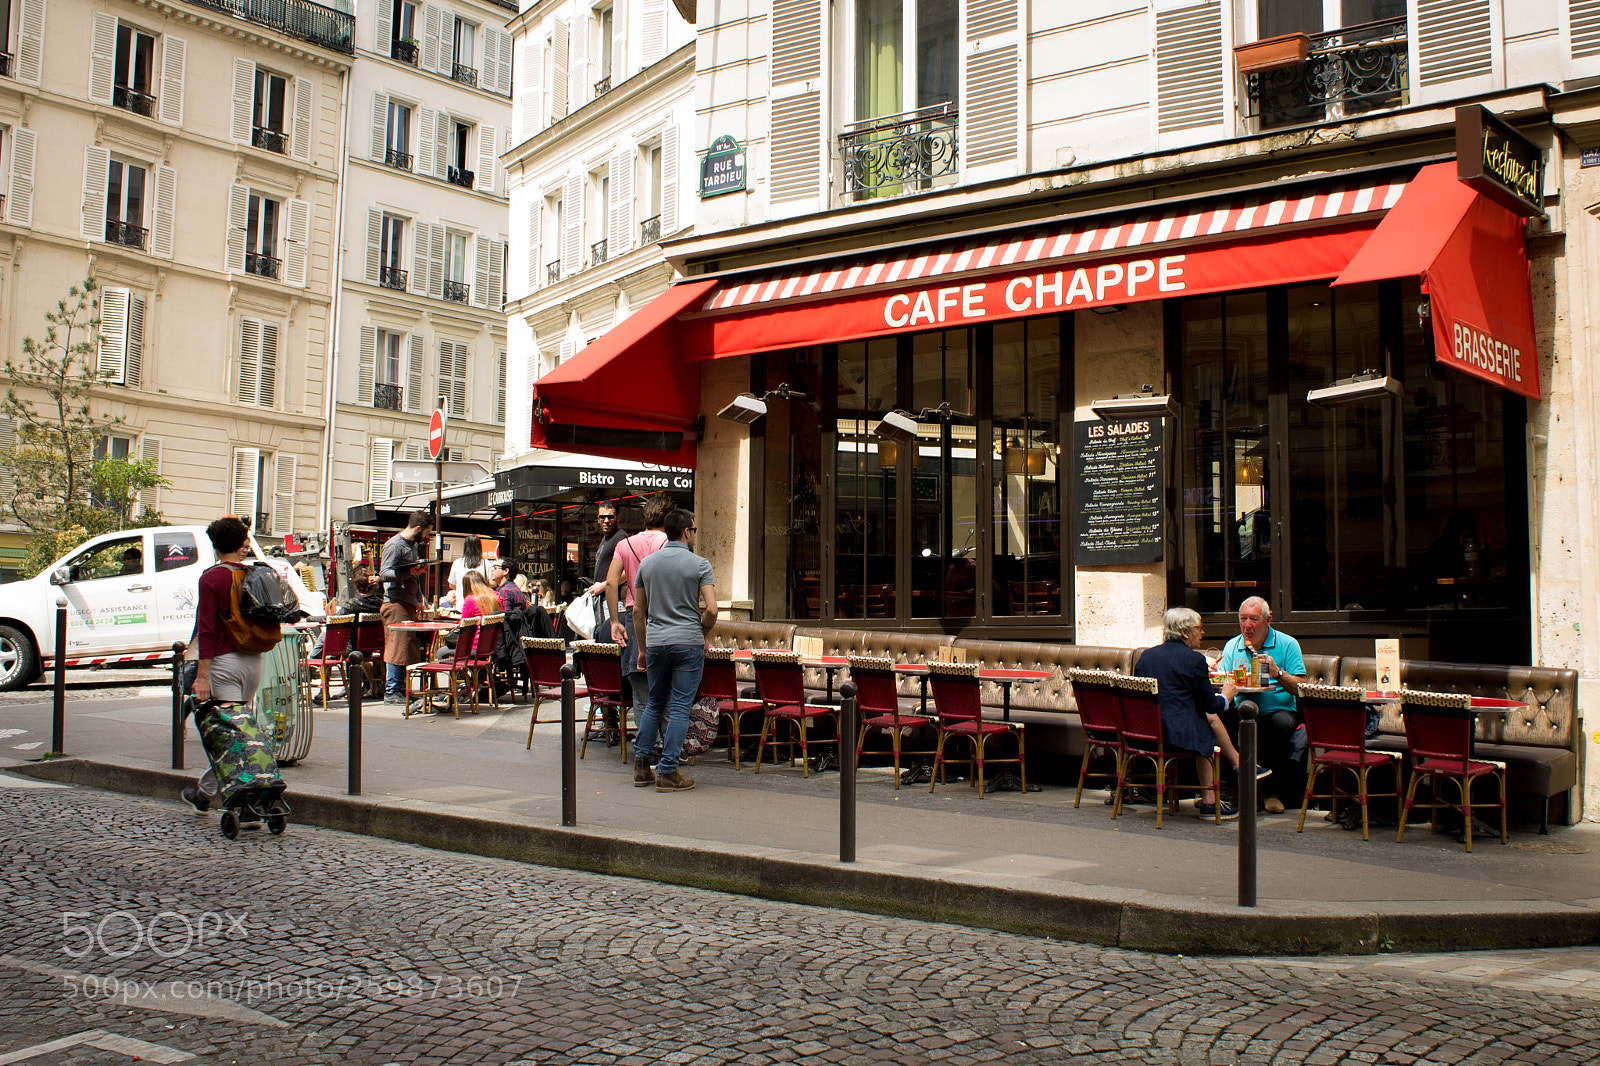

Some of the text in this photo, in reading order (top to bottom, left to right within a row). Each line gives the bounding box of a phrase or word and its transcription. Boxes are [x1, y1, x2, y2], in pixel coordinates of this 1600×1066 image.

[714, 160, 732, 173] RUE
[704, 170, 742, 188] TARDIEU
[884, 255, 1186, 328] CAFE CHAPPE
[1454, 322, 1522, 382] BRASSERIE
[1088, 421, 1150, 438] LES SALADES
[579, 472, 615, 485] Bistro
[625, 474, 669, 488] Service
[518, 562, 554, 576] OCKTAILS
[100, 604, 148, 614] ASSISTANCE
